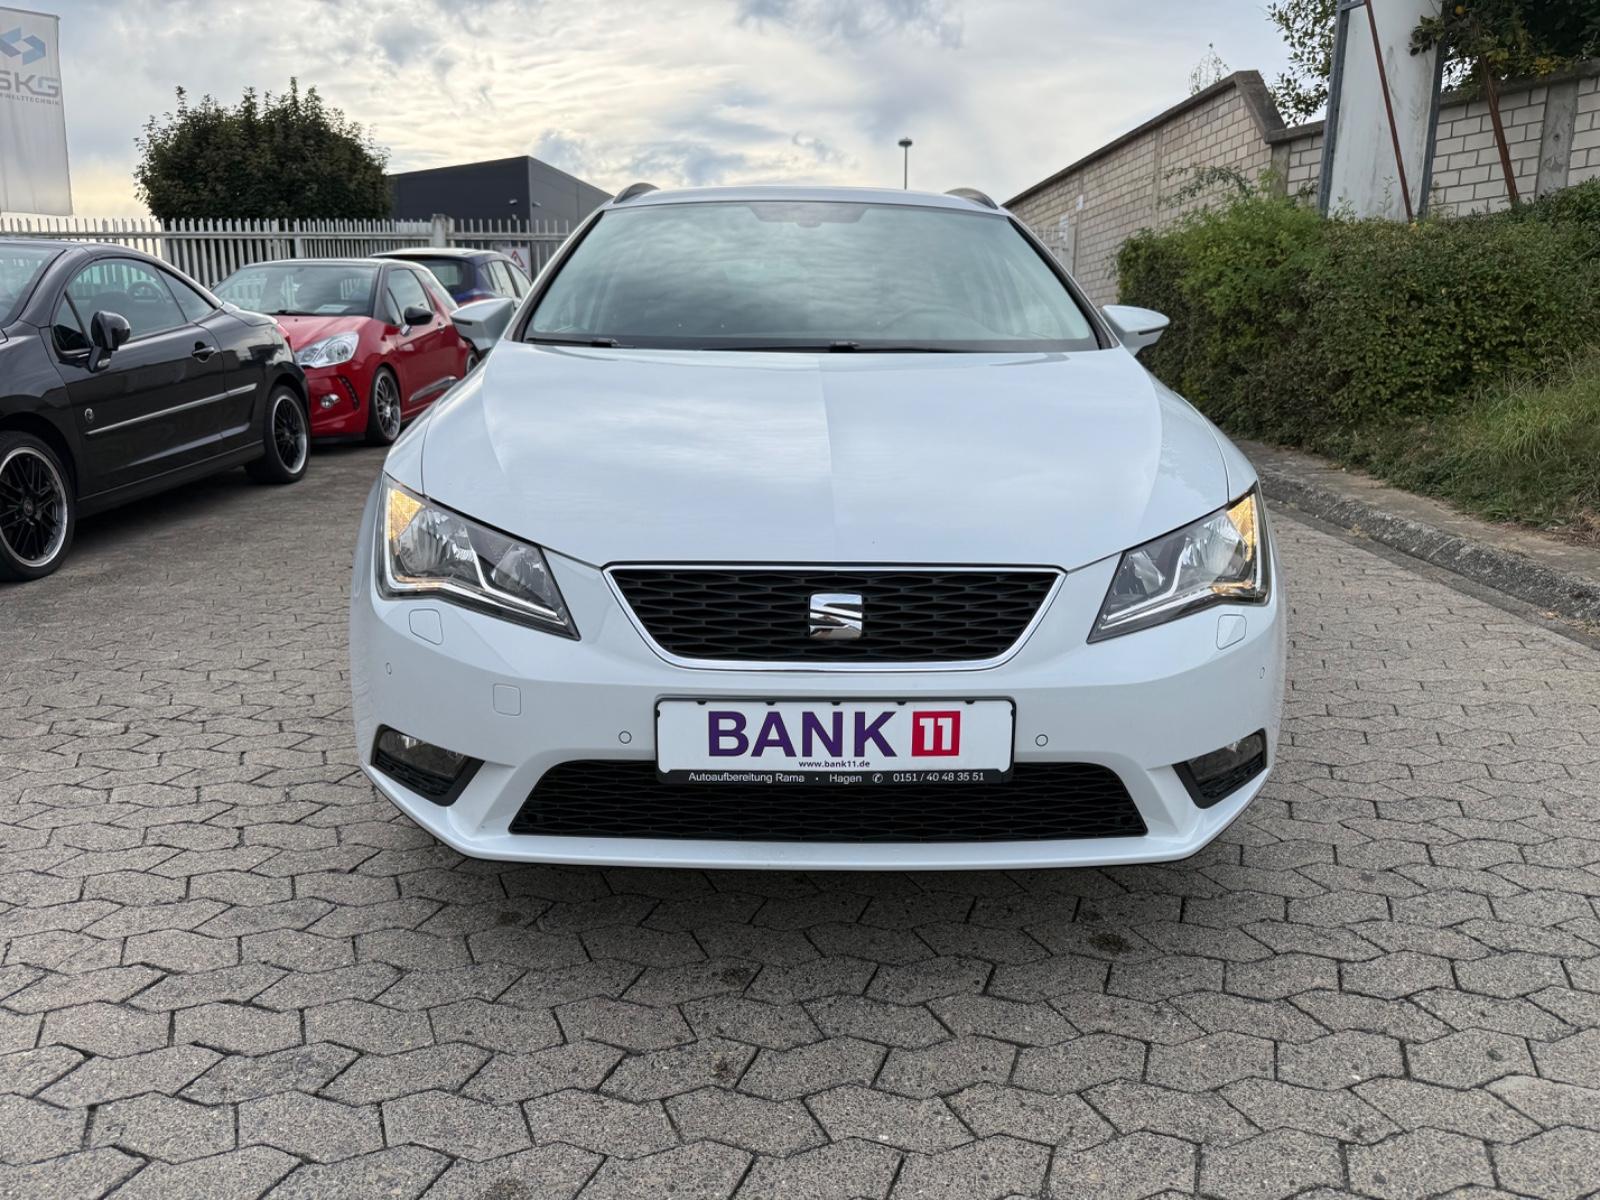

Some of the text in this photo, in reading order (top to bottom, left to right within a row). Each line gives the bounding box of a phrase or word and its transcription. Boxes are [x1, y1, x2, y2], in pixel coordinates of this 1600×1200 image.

[708, 710, 953, 758] BANK 11
[798, 759, 871, 769] www.bank11.de
[688, 772, 773, 784] Autoaufbereitung
[775, 772, 805, 783] Rama
[829, 773, 862, 785] Hagen
[892, 773, 917, 782] 0151
[926, 772, 940, 782] 40
[941, 772, 955, 782] 48
[957, 772, 970, 782] 35
[972, 771, 985, 781] 51
